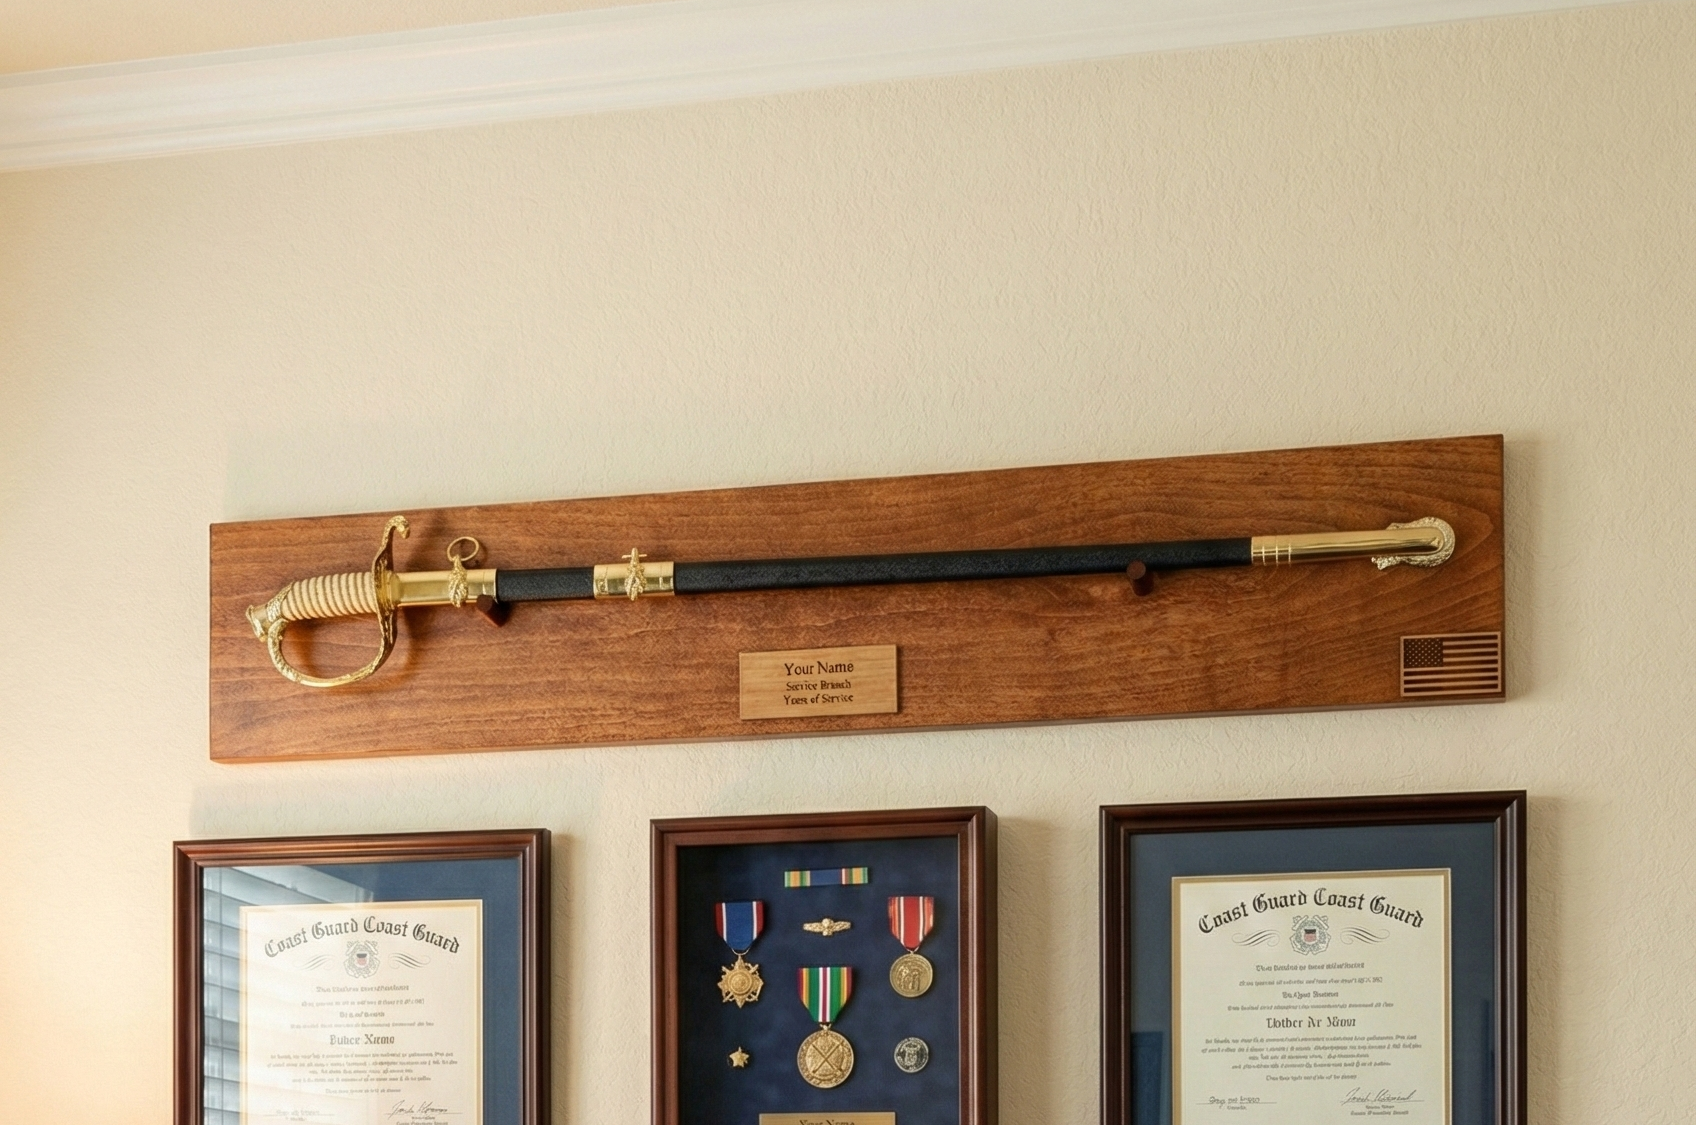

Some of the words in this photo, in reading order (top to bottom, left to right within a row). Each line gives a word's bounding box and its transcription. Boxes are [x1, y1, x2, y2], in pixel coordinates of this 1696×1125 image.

[784, 662, 814, 676] Your
[816, 661, 854, 675] Name
[1198, 901, 1249, 934] Coast
[1252, 889, 1307, 913] Guard
[1313, 887, 1365, 910] Coast
[1369, 895, 1424, 928] Guard
[264, 928, 308, 958] Coast
[311, 918, 359, 940] Guard
[363, 916, 408, 937] Coast
[412, 923, 460, 954] Guard
